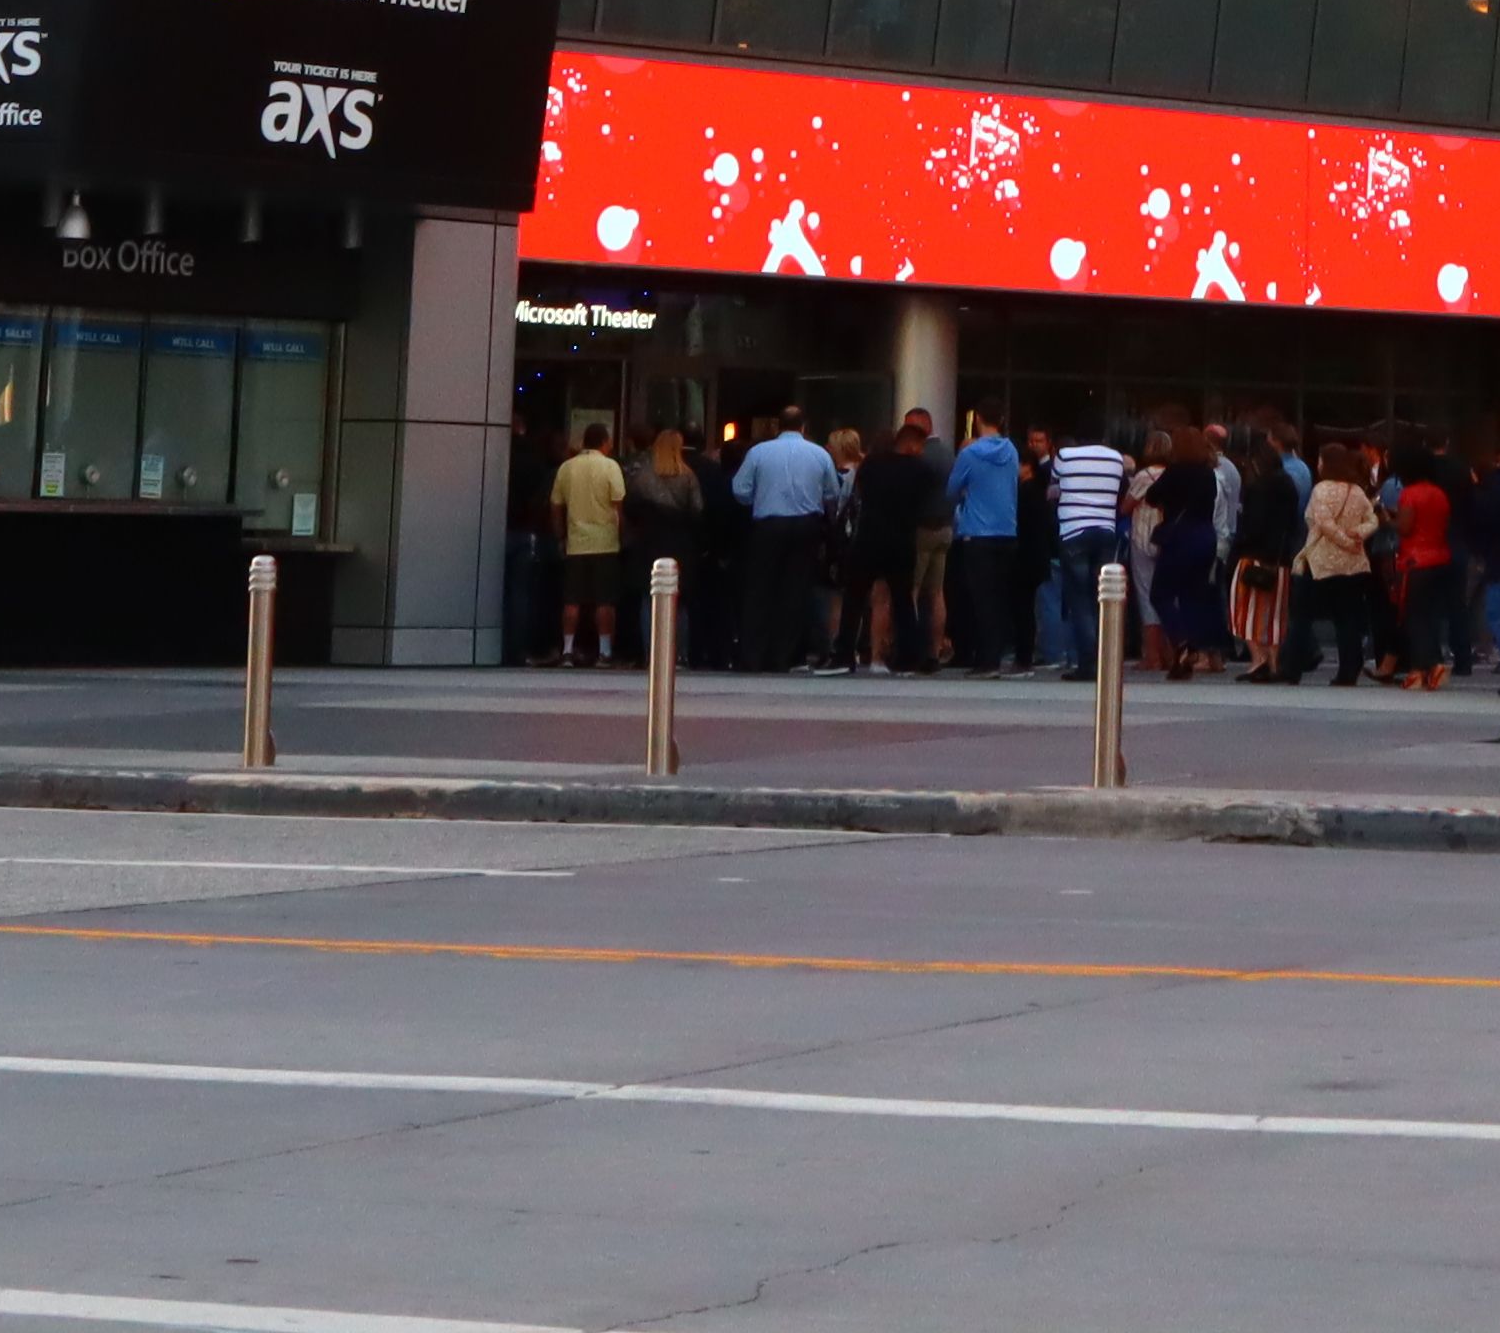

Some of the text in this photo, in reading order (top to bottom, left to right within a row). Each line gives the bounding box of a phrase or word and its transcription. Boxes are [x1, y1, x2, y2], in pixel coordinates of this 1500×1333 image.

[274, 60, 378, 83] YOUR TICKET IS HERE
[261, 81, 376, 160] axs
[63, 240, 195, 277] Box Office
[590, 304, 657, 330] Theater
